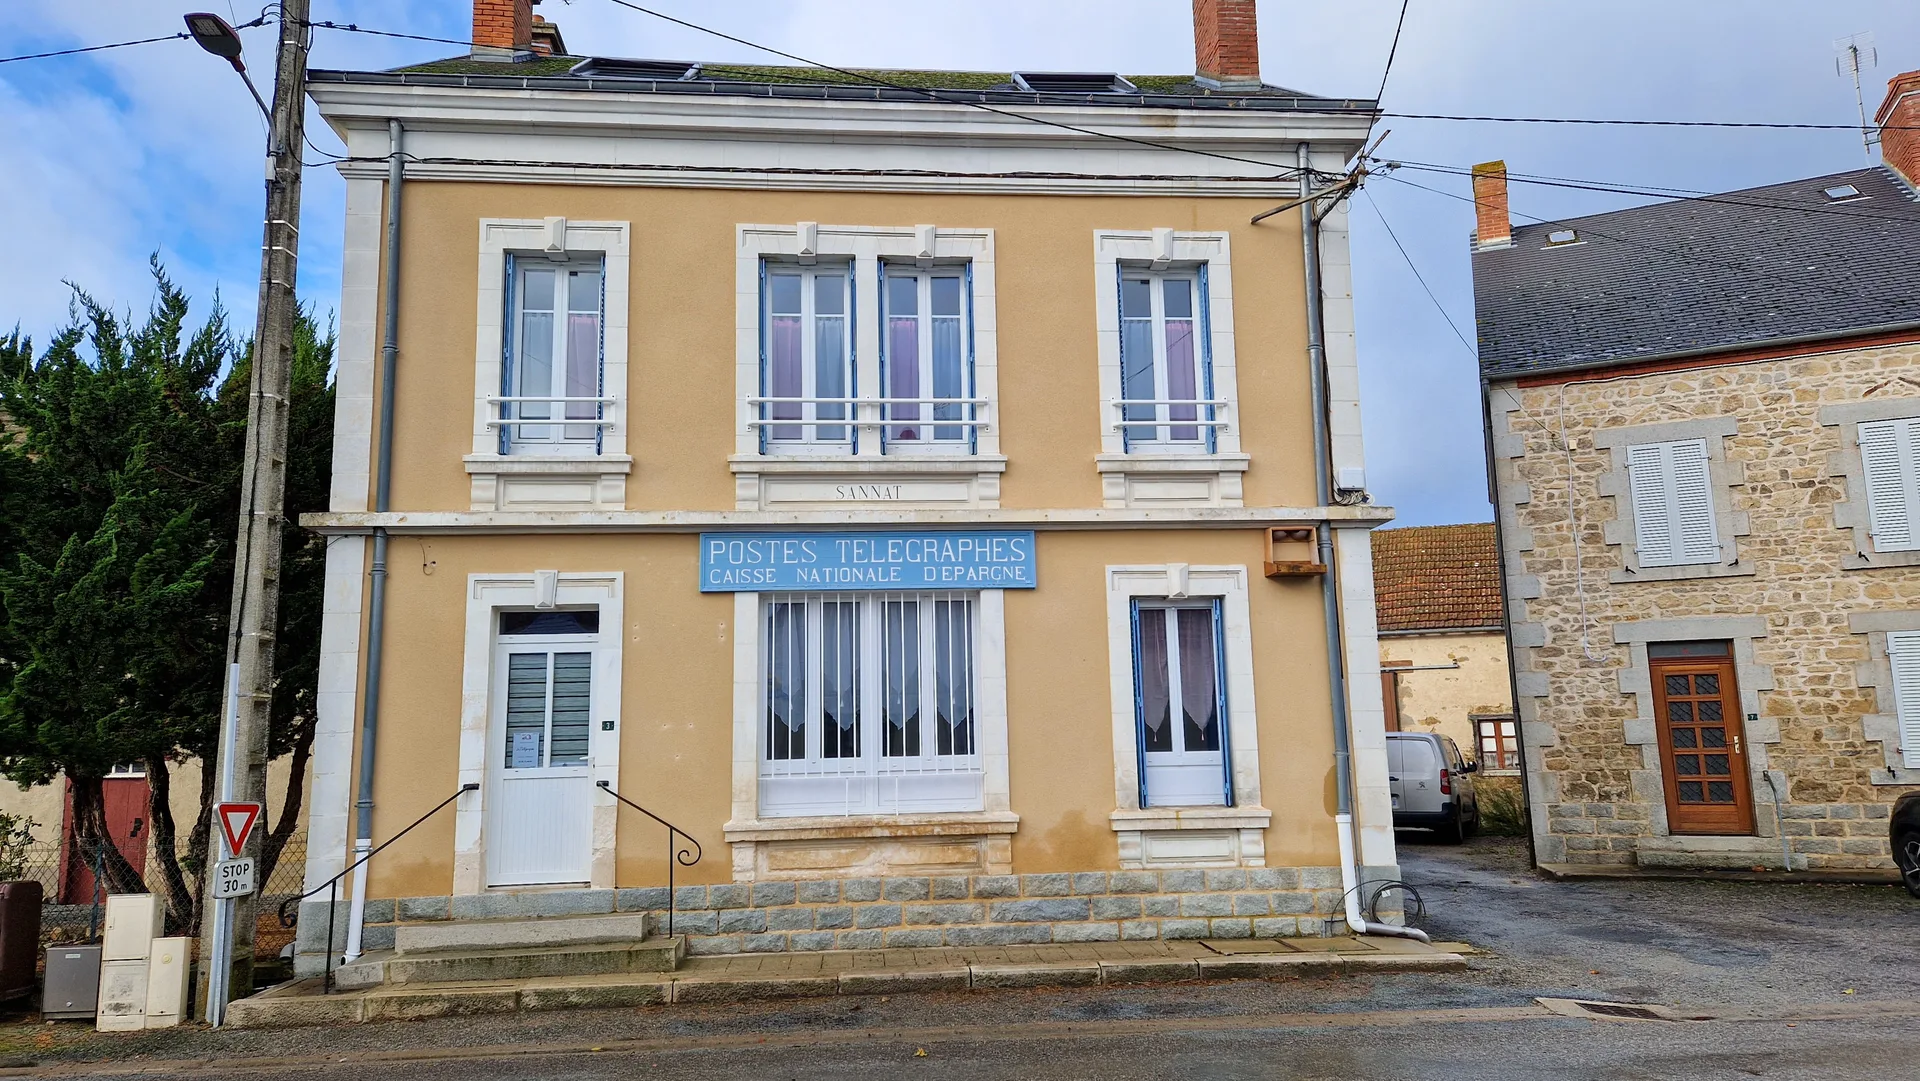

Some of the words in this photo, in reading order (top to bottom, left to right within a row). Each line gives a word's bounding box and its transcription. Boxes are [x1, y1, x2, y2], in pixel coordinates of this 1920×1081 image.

[836, 485, 902, 499] SANNAT
[710, 540, 816, 564] POSTES
[836, 538, 1026, 562] TELEGRAPHES
[710, 568, 776, 583] CAISSE
[797, 567, 901, 582] NATIONALE
[924, 566, 1026, 581] D'EPARGNE
[222, 863, 250, 878] STOP
[223, 879, 239, 893] 30
